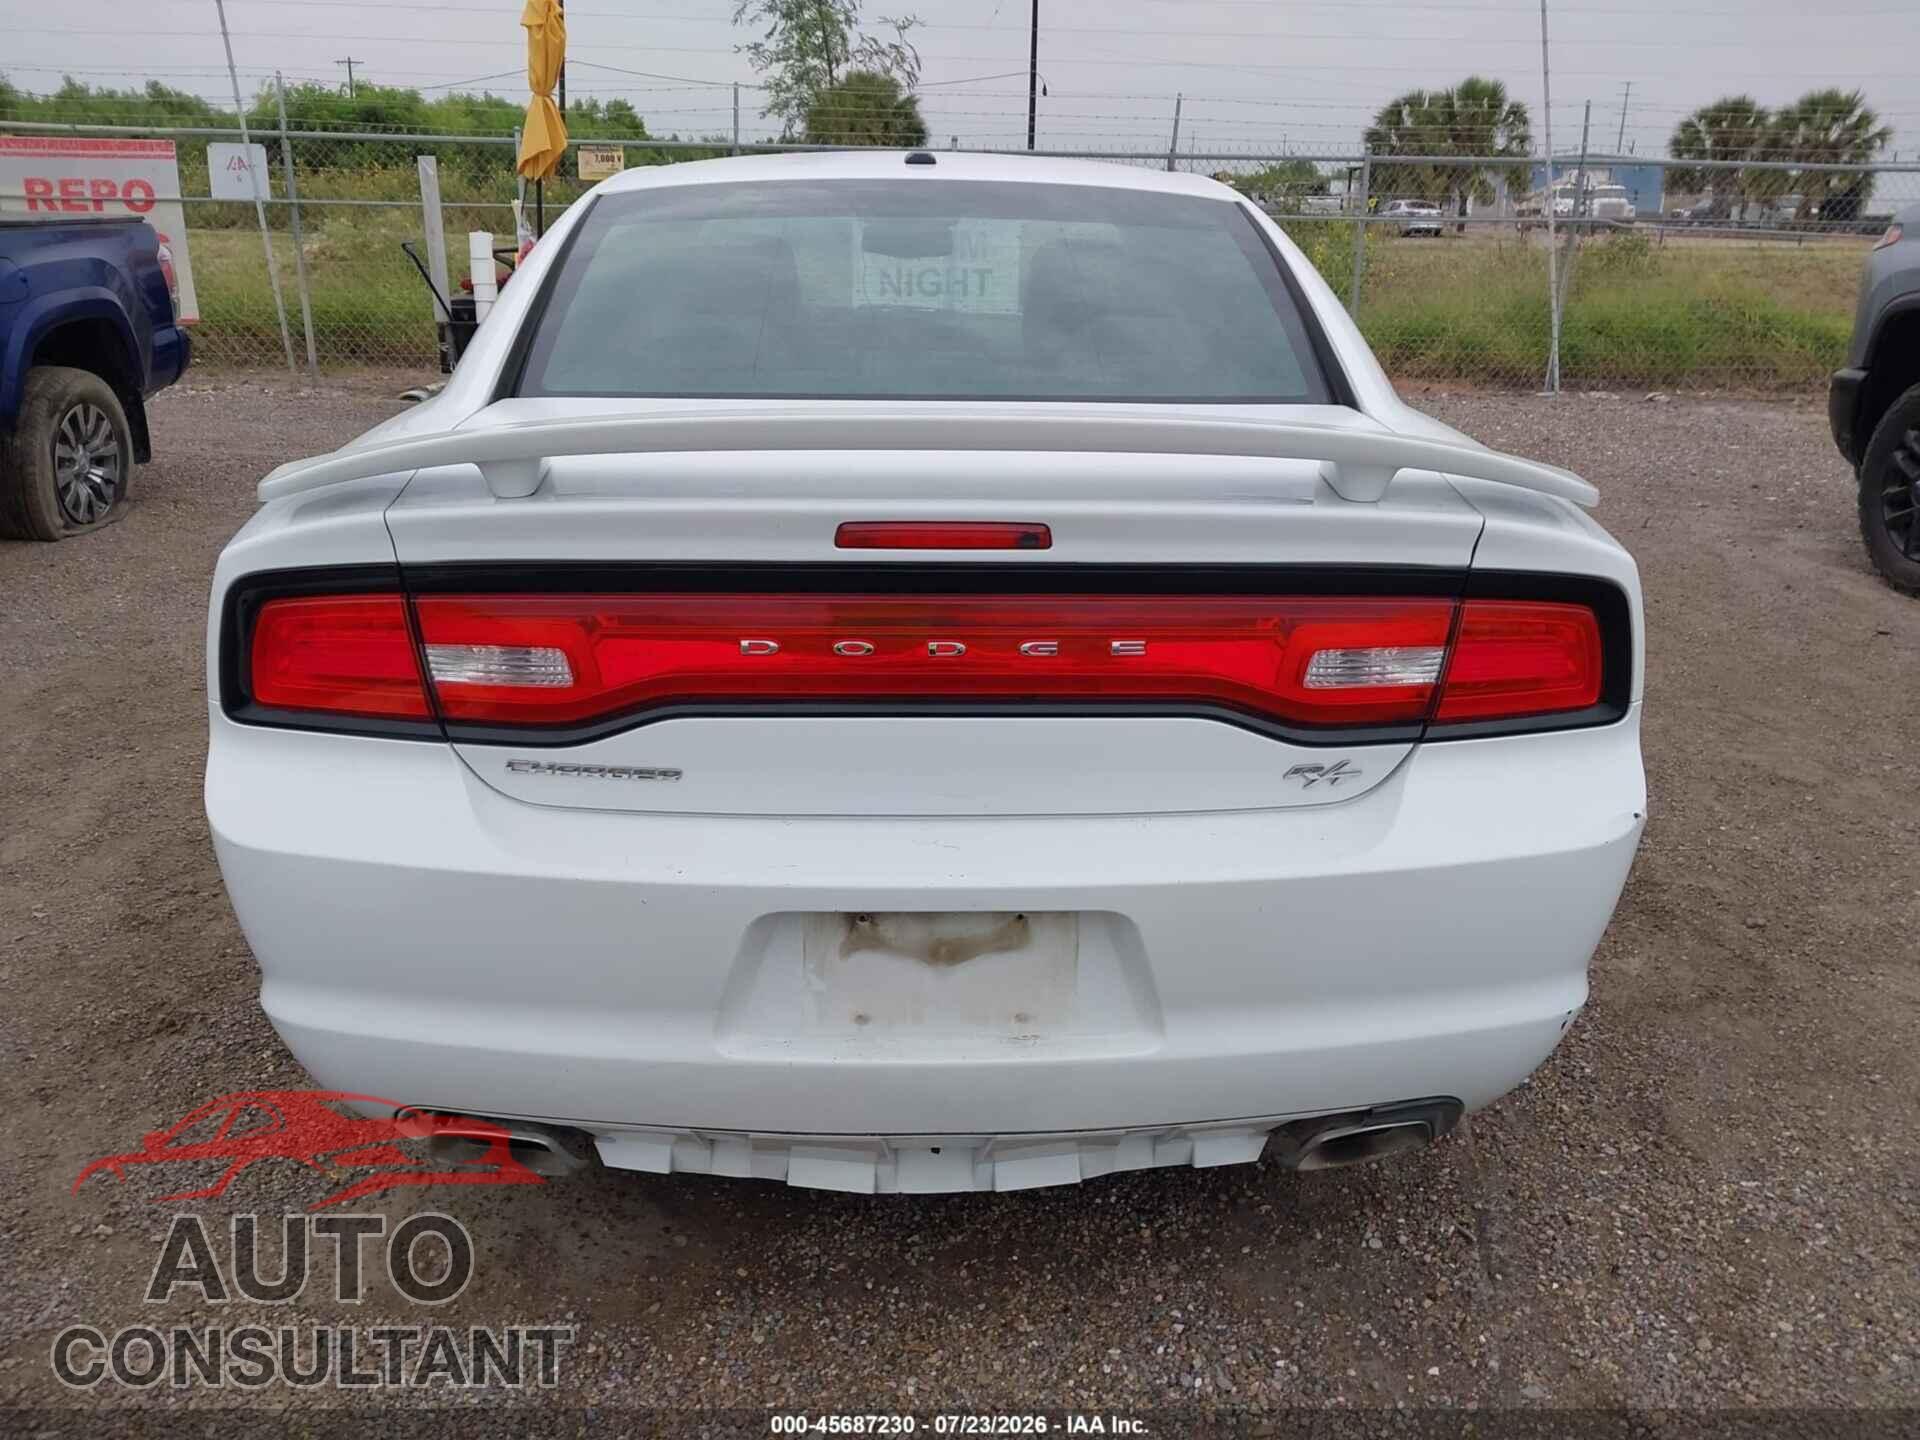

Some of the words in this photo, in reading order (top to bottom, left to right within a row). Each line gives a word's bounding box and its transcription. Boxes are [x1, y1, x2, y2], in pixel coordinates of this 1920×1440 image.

[23, 177, 156, 212] REPO
[879, 267, 993, 297] NIGHT
[739, 639, 1147, 657] DODGE
[506, 759, 683, 780] CHARGER
[1282, 759, 1363, 789] R/T
